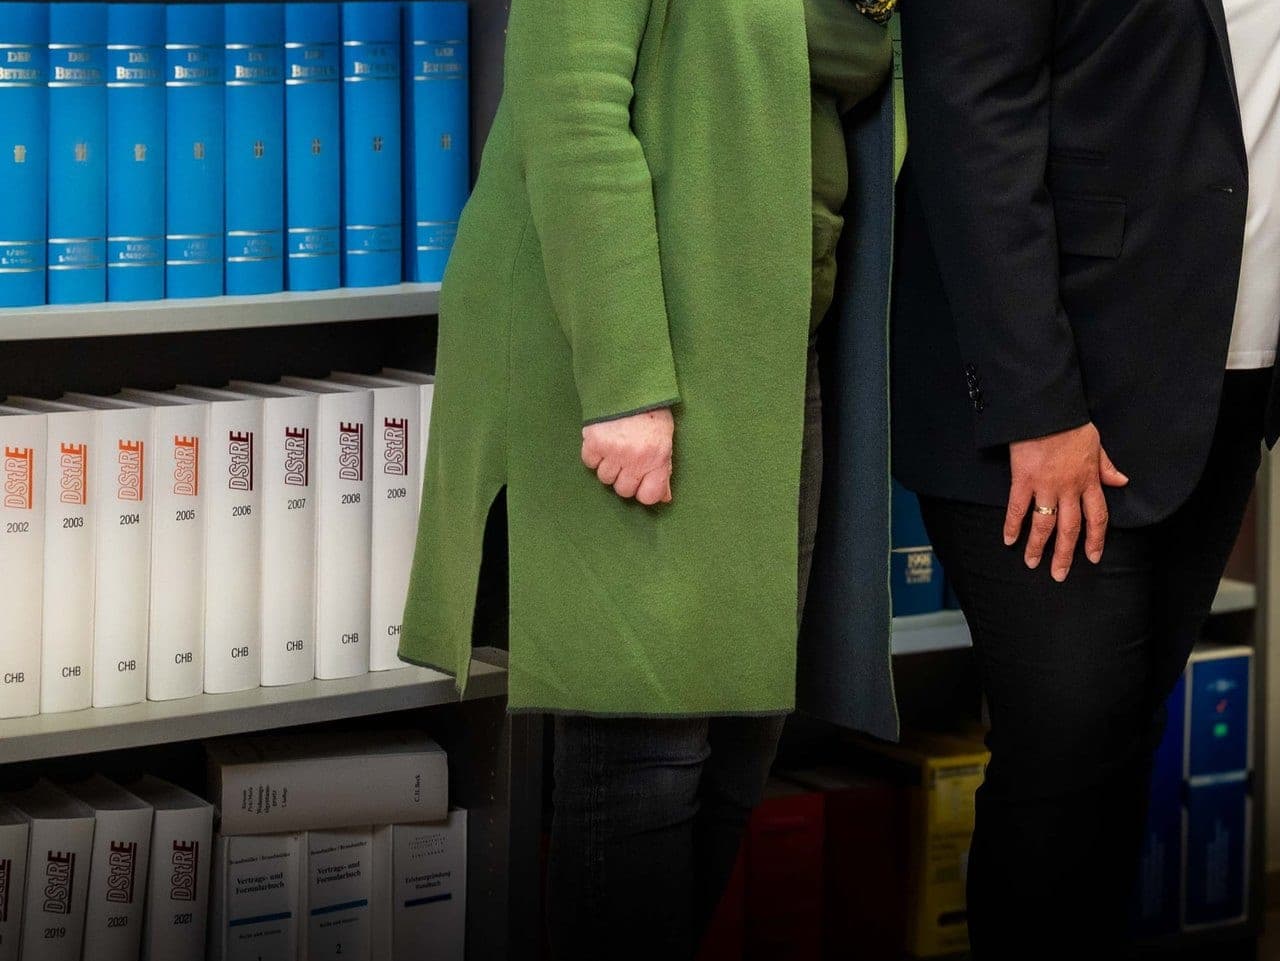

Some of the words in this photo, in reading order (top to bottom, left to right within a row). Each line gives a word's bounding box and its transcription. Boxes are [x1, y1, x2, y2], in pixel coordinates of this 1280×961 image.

[339, 422, 363, 481] DStRE
[384, 417, 408, 475] DStRE
[229, 431, 253, 491] DStRE
[285, 427, 309, 486] DStRE
[118, 439, 144, 501] DStRE
[174, 435, 199, 496] DStRE
[4, 446, 34, 509] DStRE
[60, 442, 87, 504] DStRE
[341, 493, 361, 505] 2008
[387, 487, 406, 499] 2009
[287, 498, 306, 510] 2007
[175, 509, 196, 521] 2005
[232, 505, 252, 517] 2006
[62, 517, 84, 529] 2003
[119, 513, 140, 525] 2004
[6, 521, 29, 533] 2002
[387, 625, 402, 637] CH
[341, 632, 360, 644] CHB
[231, 646, 249, 658] CHB
[286, 640, 304, 652] CHB
[174, 652, 193, 664] CHB
[62, 666, 81, 678] CHB
[117, 660, 136, 672] CHB
[4, 672, 25, 684] CHB
[107, 841, 138, 904] DStRE
[171, 840, 199, 901] DStRE
[317, 864, 346, 876] Vertrags-
[347, 860, 360, 869] und
[43, 851, 76, 914] DStRE
[236, 875, 269, 886] Vertrags-
[269, 872, 283, 881] und
[316, 870, 362, 884] Formularbuch
[235, 881, 285, 895] Formularbuch
[107, 915, 128, 927] 2020
[173, 913, 193, 925] 2021
[44, 927, 66, 939] 2019
[335, 943, 342, 954] 2
